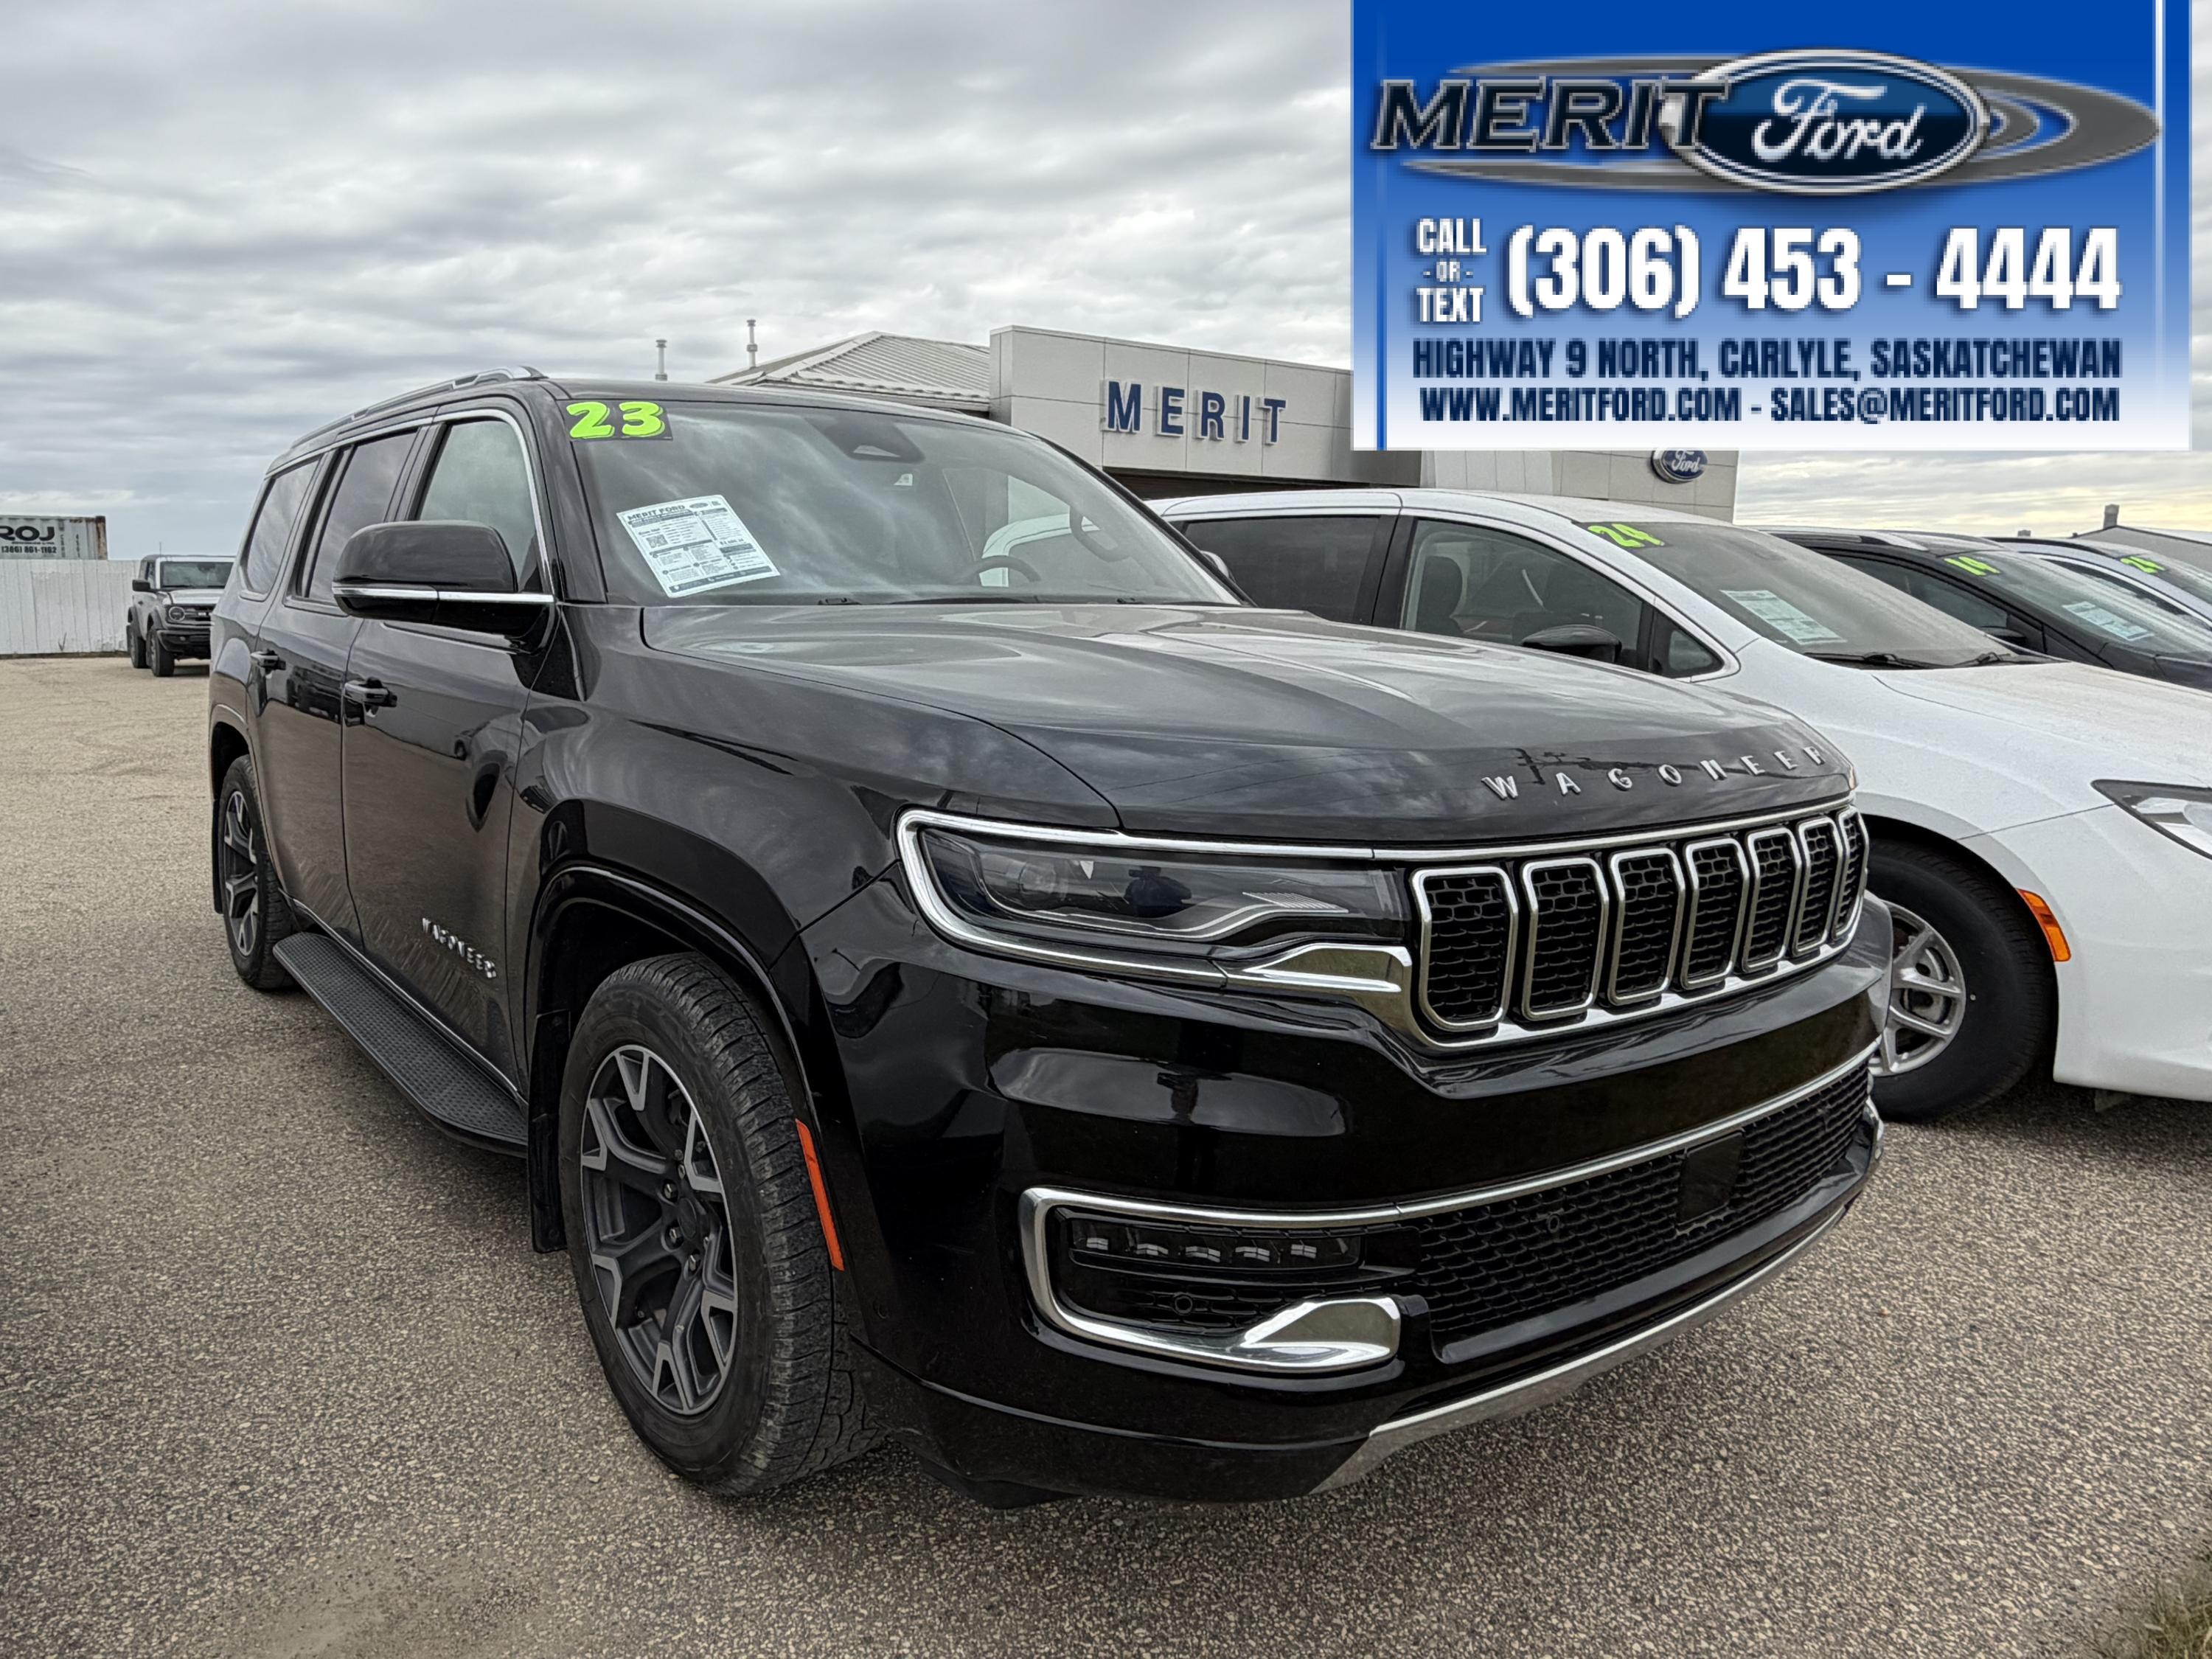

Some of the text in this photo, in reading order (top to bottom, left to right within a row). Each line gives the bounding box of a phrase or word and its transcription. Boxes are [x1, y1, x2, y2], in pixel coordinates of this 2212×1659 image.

[566, 402, 666, 439] 23
[1106, 380, 1287, 443] MERIT
[1671, 449, 1700, 473] Ford
[658, 504, 686, 514] FORD
[1587, 524, 1666, 548] 24
[1481, 745, 1826, 800] WAGONEER
